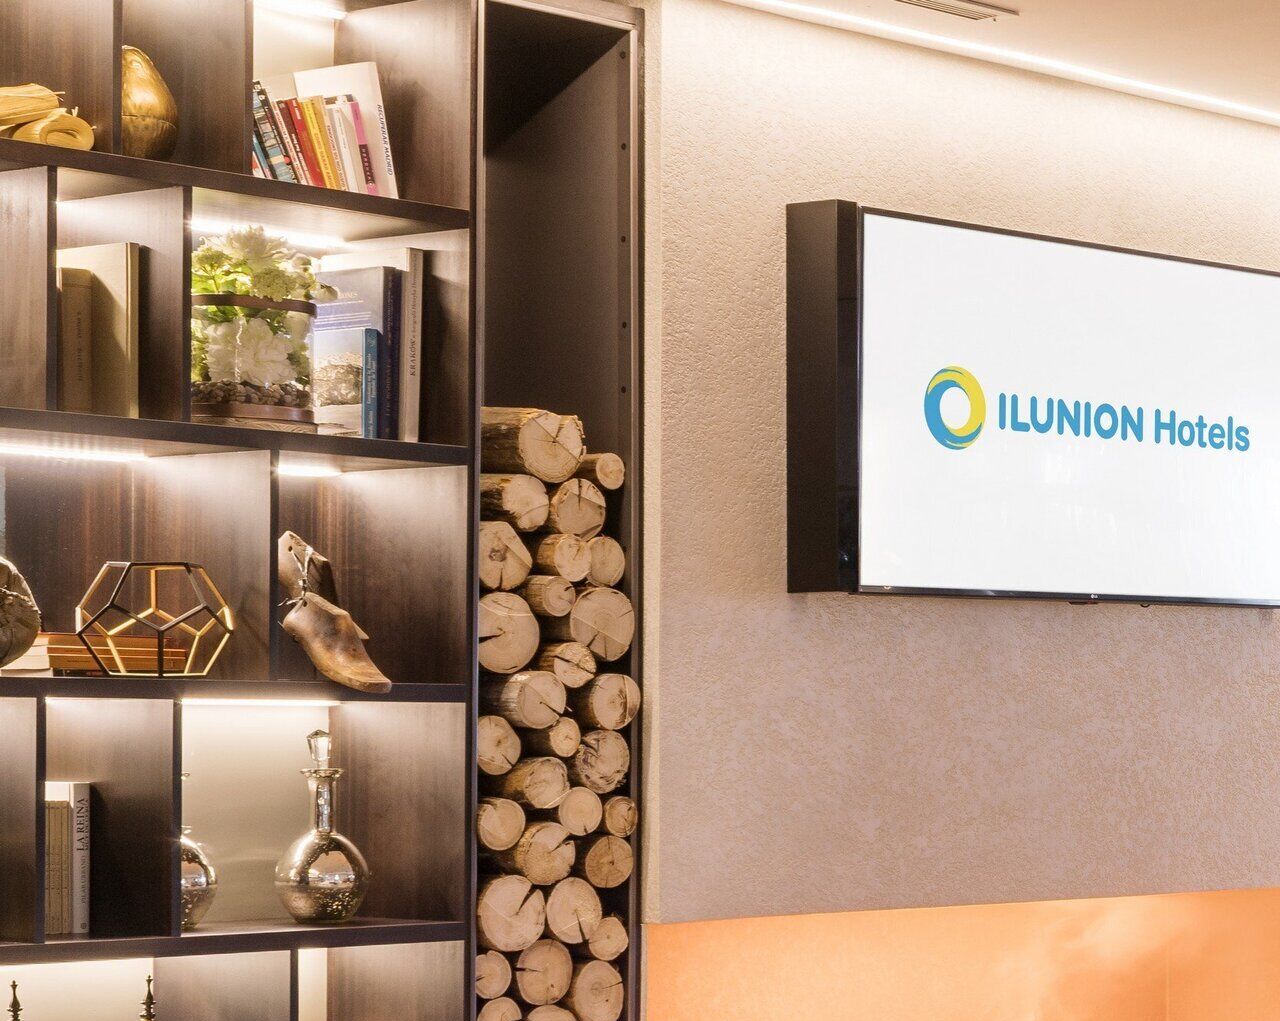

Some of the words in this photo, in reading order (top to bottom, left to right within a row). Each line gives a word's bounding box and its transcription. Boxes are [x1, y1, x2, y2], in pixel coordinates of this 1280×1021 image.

[377, 104, 388, 145] RECUPERAR
[384, 146, 393, 176] MADRID
[999, 393, 1143, 442] ILUNION
[1155, 409, 1250, 451] Hotels
[77, 837, 84, 851] LA
